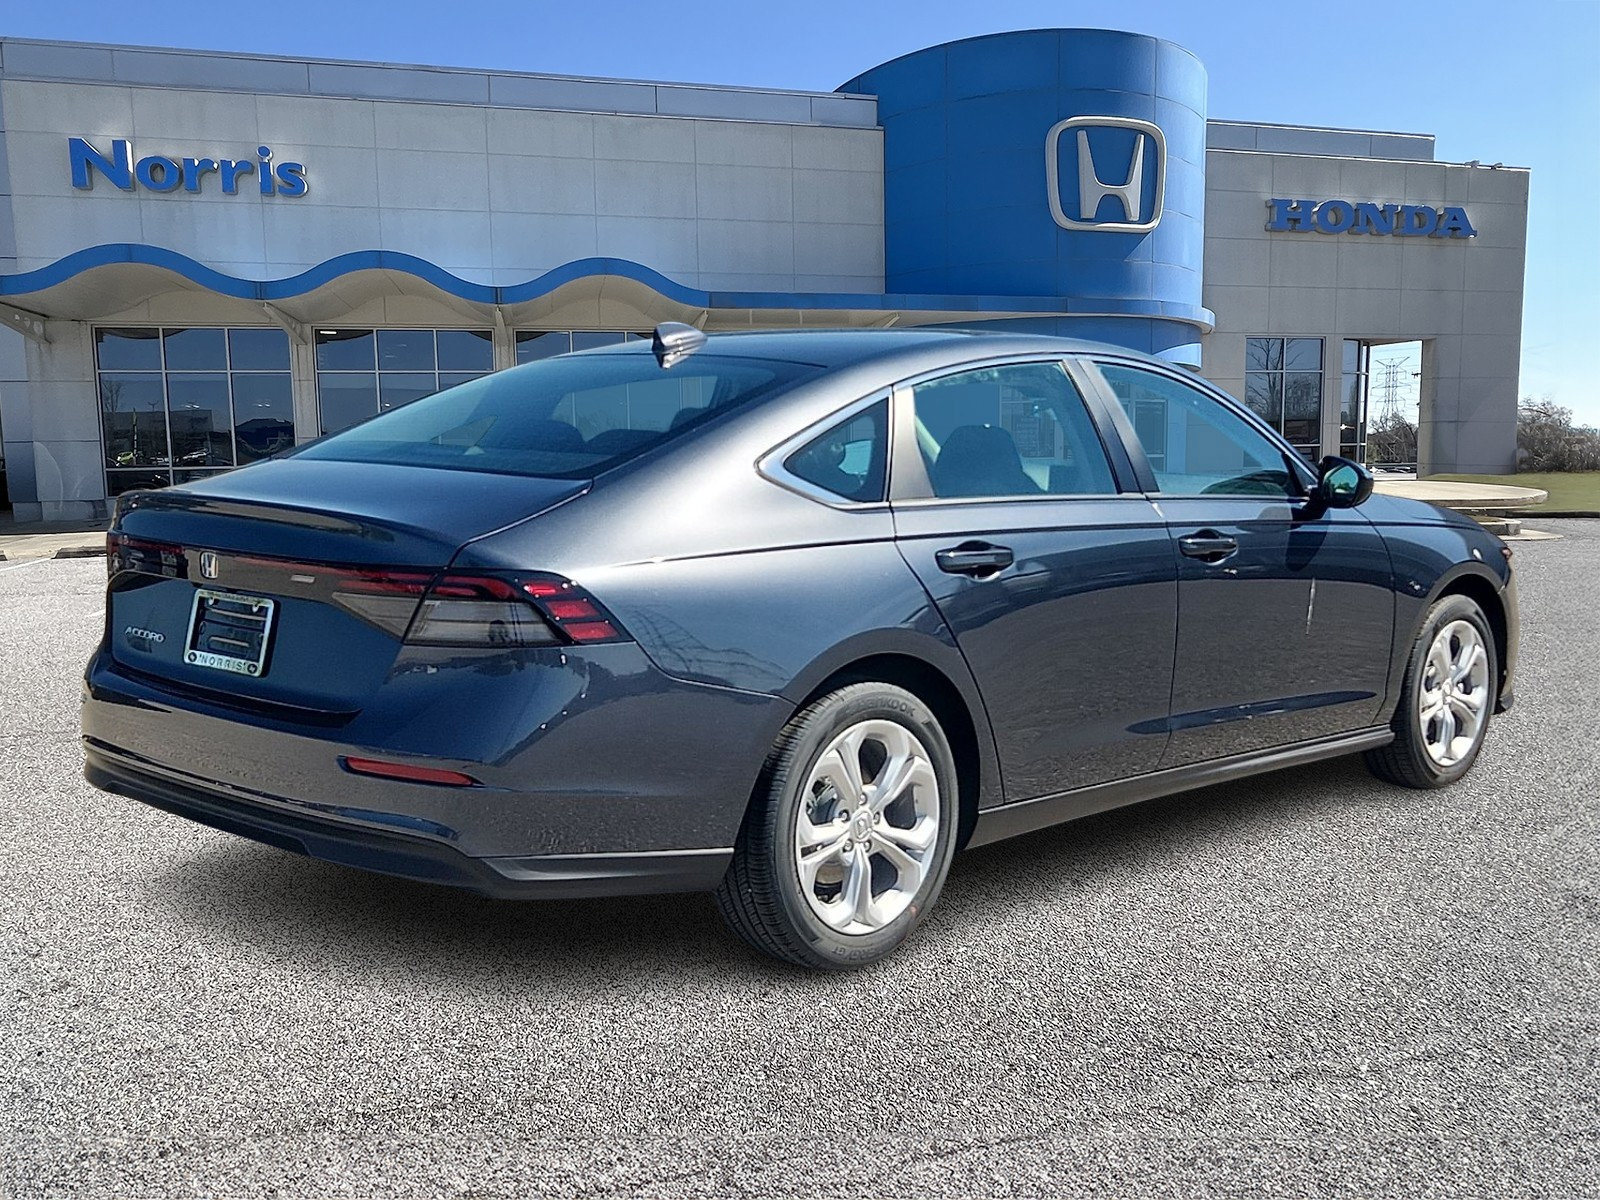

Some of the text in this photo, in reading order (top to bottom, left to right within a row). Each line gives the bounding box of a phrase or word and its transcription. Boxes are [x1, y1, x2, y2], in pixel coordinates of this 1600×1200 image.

[68, 137, 309, 197] Norris
[1266, 198, 1478, 239] HONDA
[125, 626, 165, 643] ACCORD
